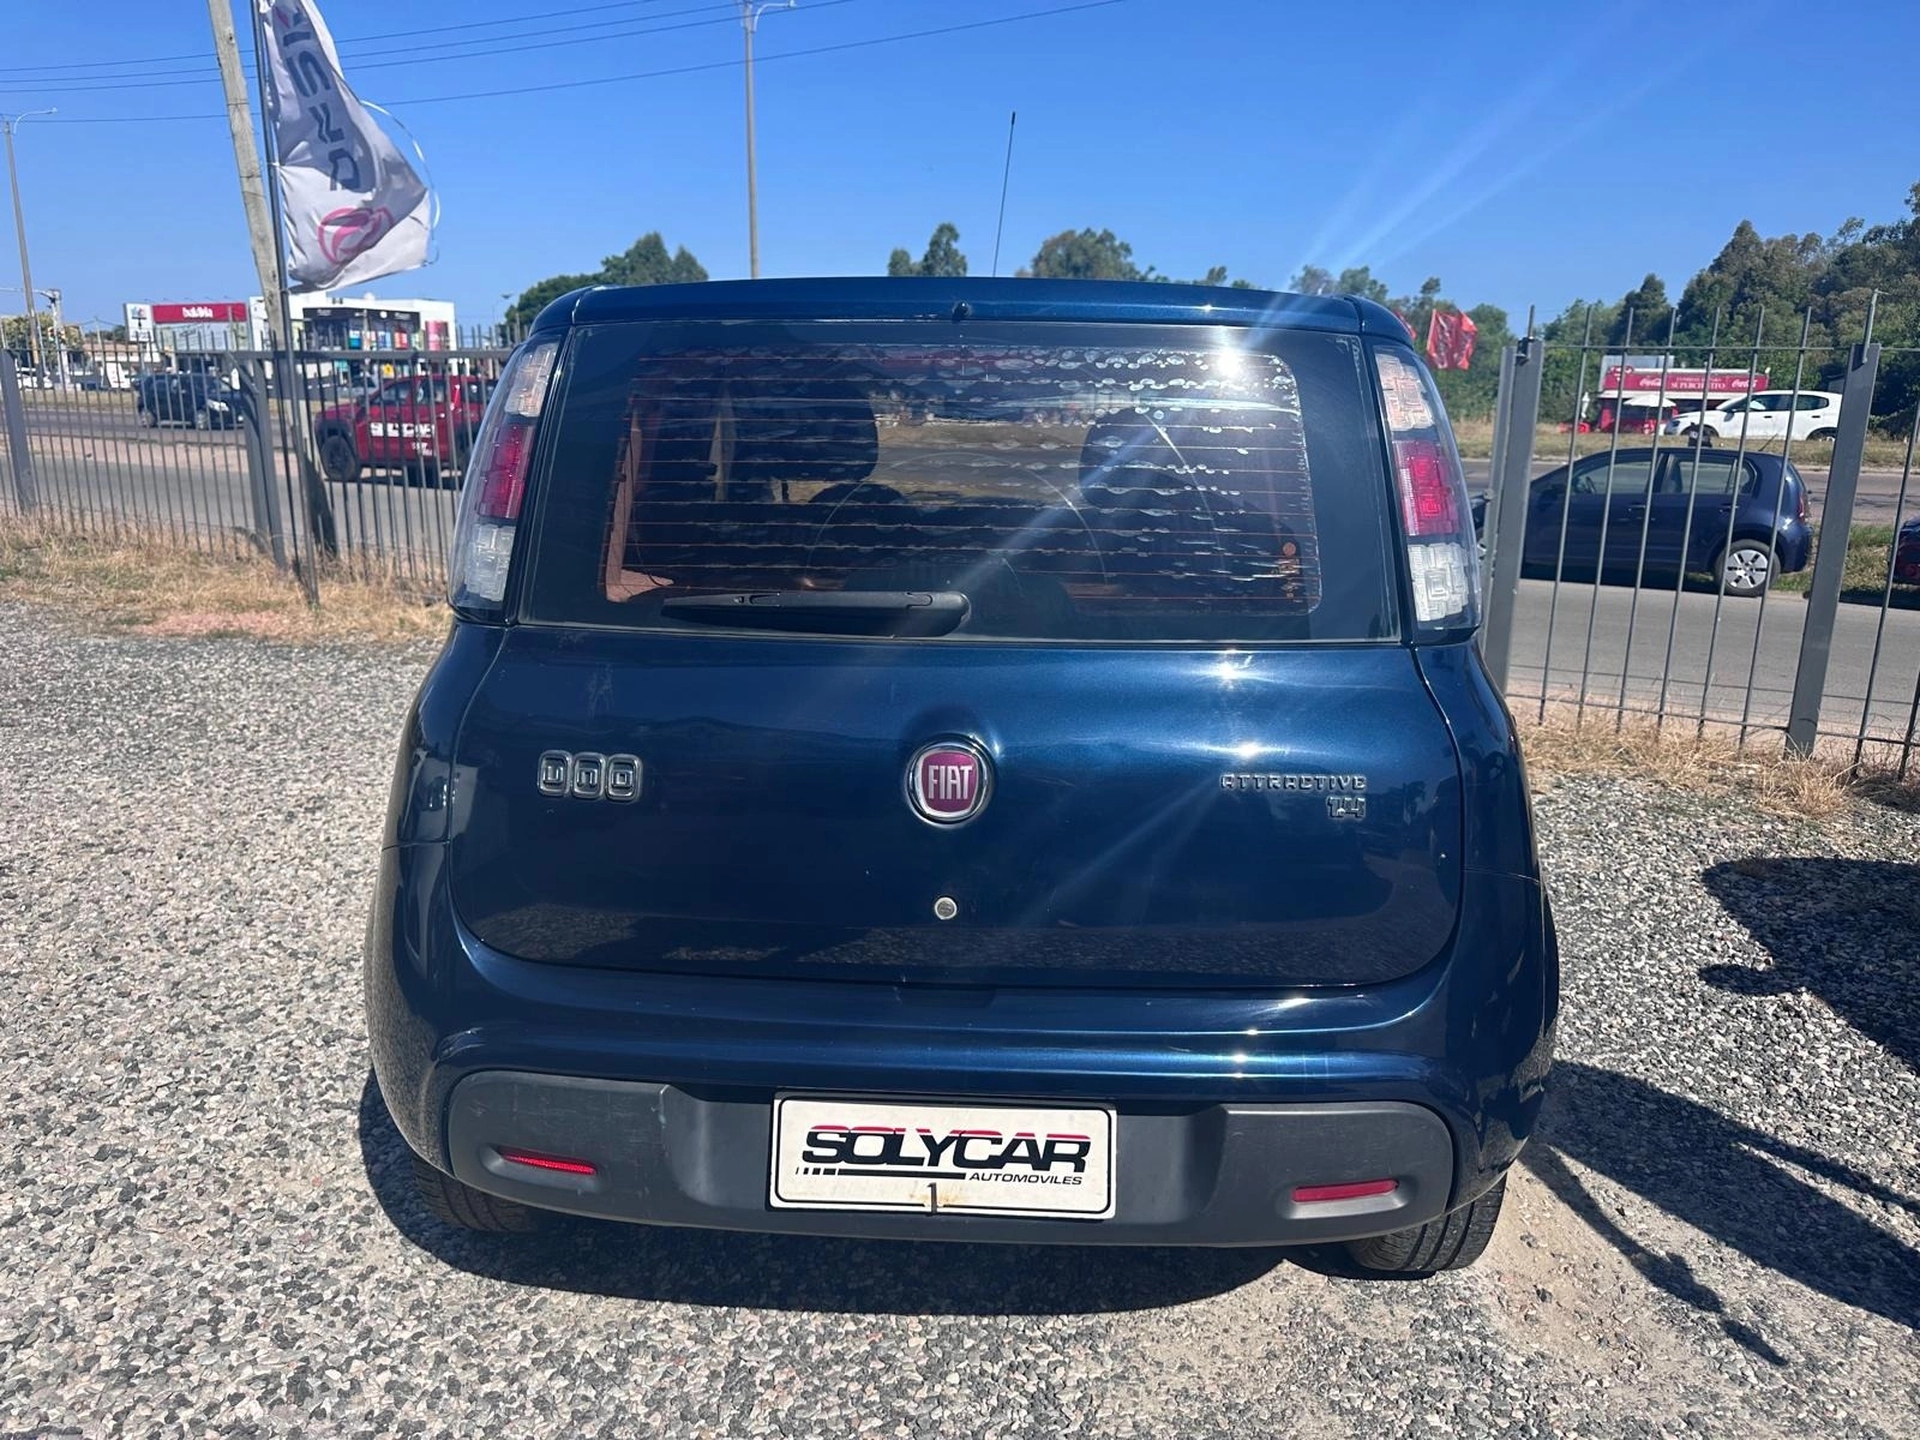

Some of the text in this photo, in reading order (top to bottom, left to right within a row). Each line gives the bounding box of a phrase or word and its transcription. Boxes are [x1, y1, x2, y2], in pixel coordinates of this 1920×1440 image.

[928, 765, 973, 800] FIAT
[1220, 772, 1367, 791] ATTRACTIVE
[1327, 796, 1367, 819] 1.4
[802, 1124, 1092, 1173] SOLYCAR
[968, 1171, 1083, 1186] AUTOMOVILES
